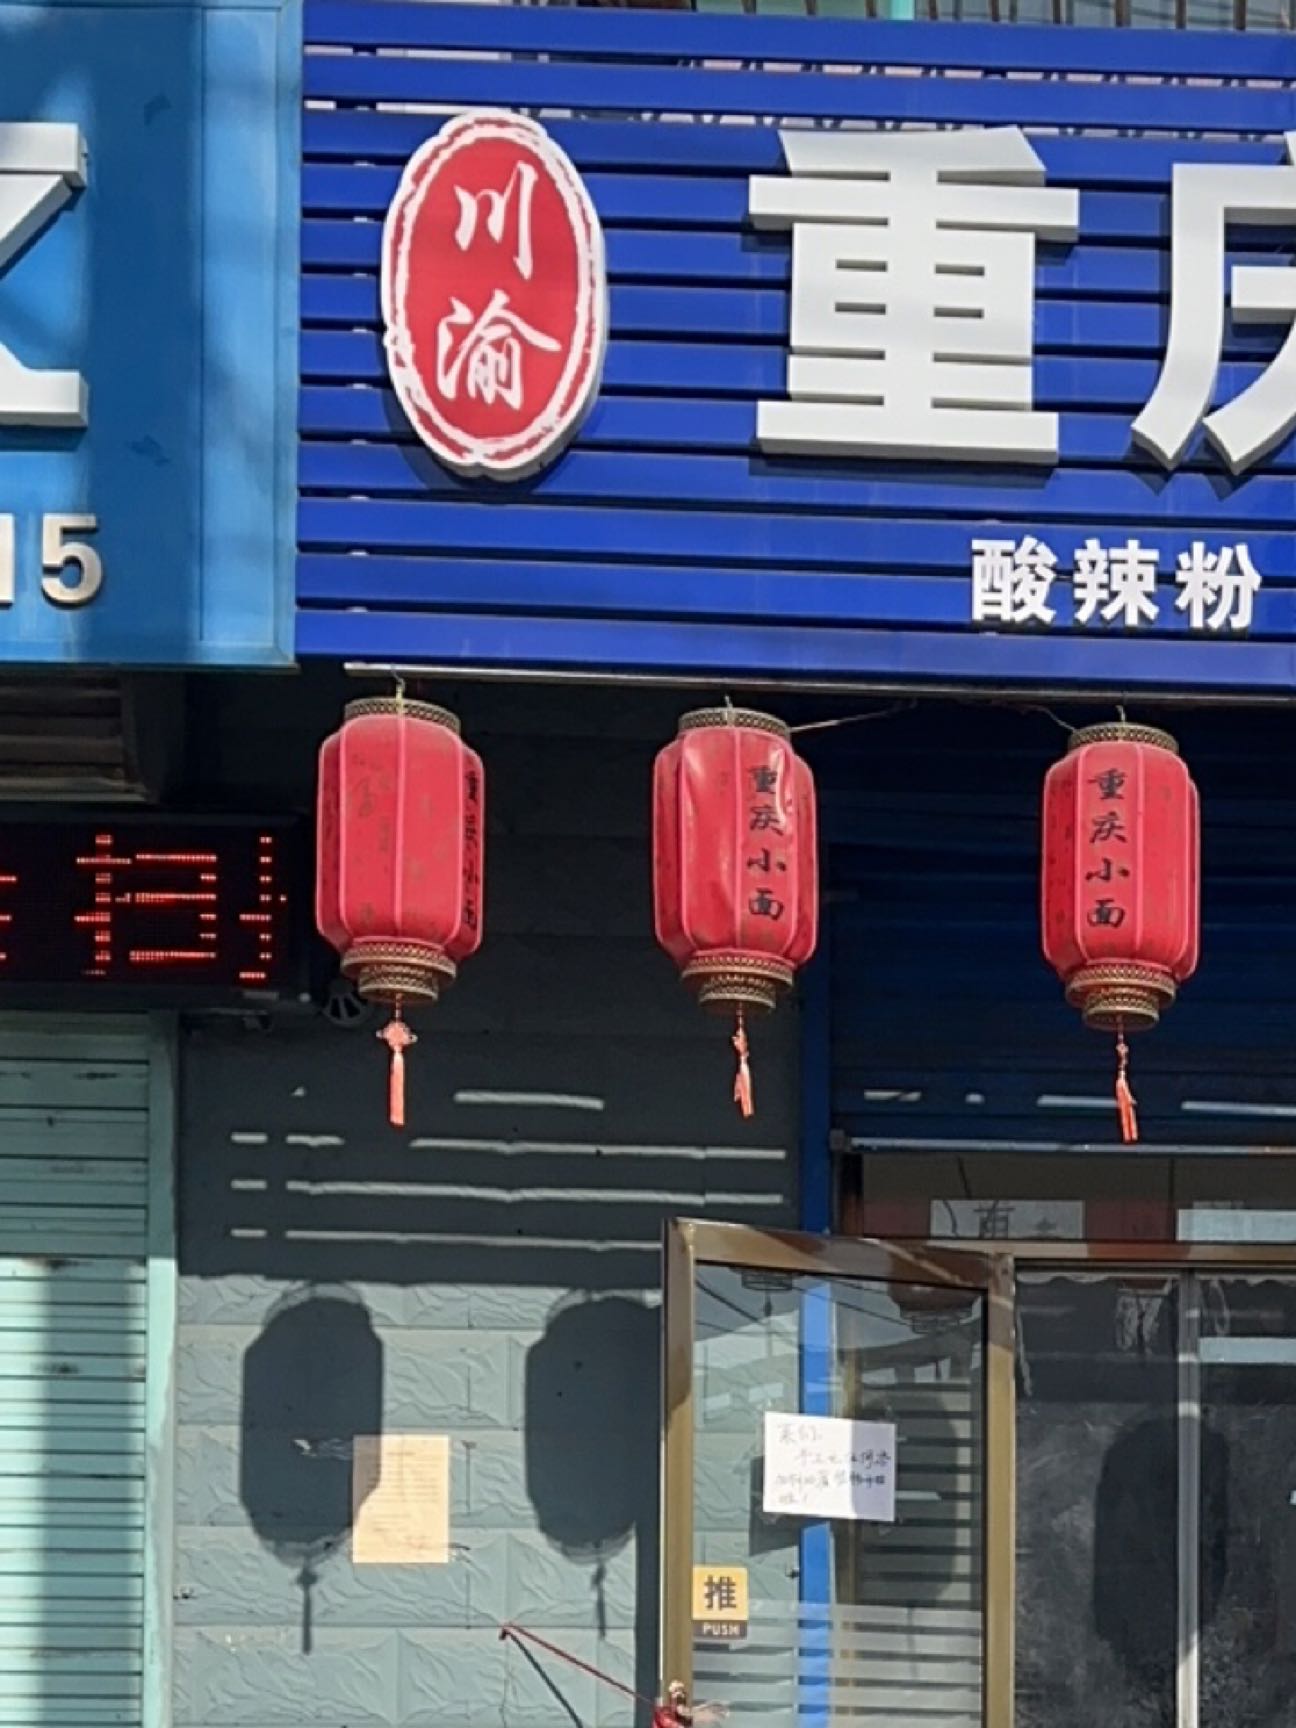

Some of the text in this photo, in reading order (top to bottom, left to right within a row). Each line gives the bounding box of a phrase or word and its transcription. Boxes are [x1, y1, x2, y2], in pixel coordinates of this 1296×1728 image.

[434, 160, 562, 411] 川渝
[971, 535, 1262, 630] 酸辣粉
[747, 765, 787, 921] 重庆小面
[1085, 768, 1130, 929] 重庆小面
[703, 1622, 741, 1636] PUSH
[704, 1574, 737, 1611] 推
